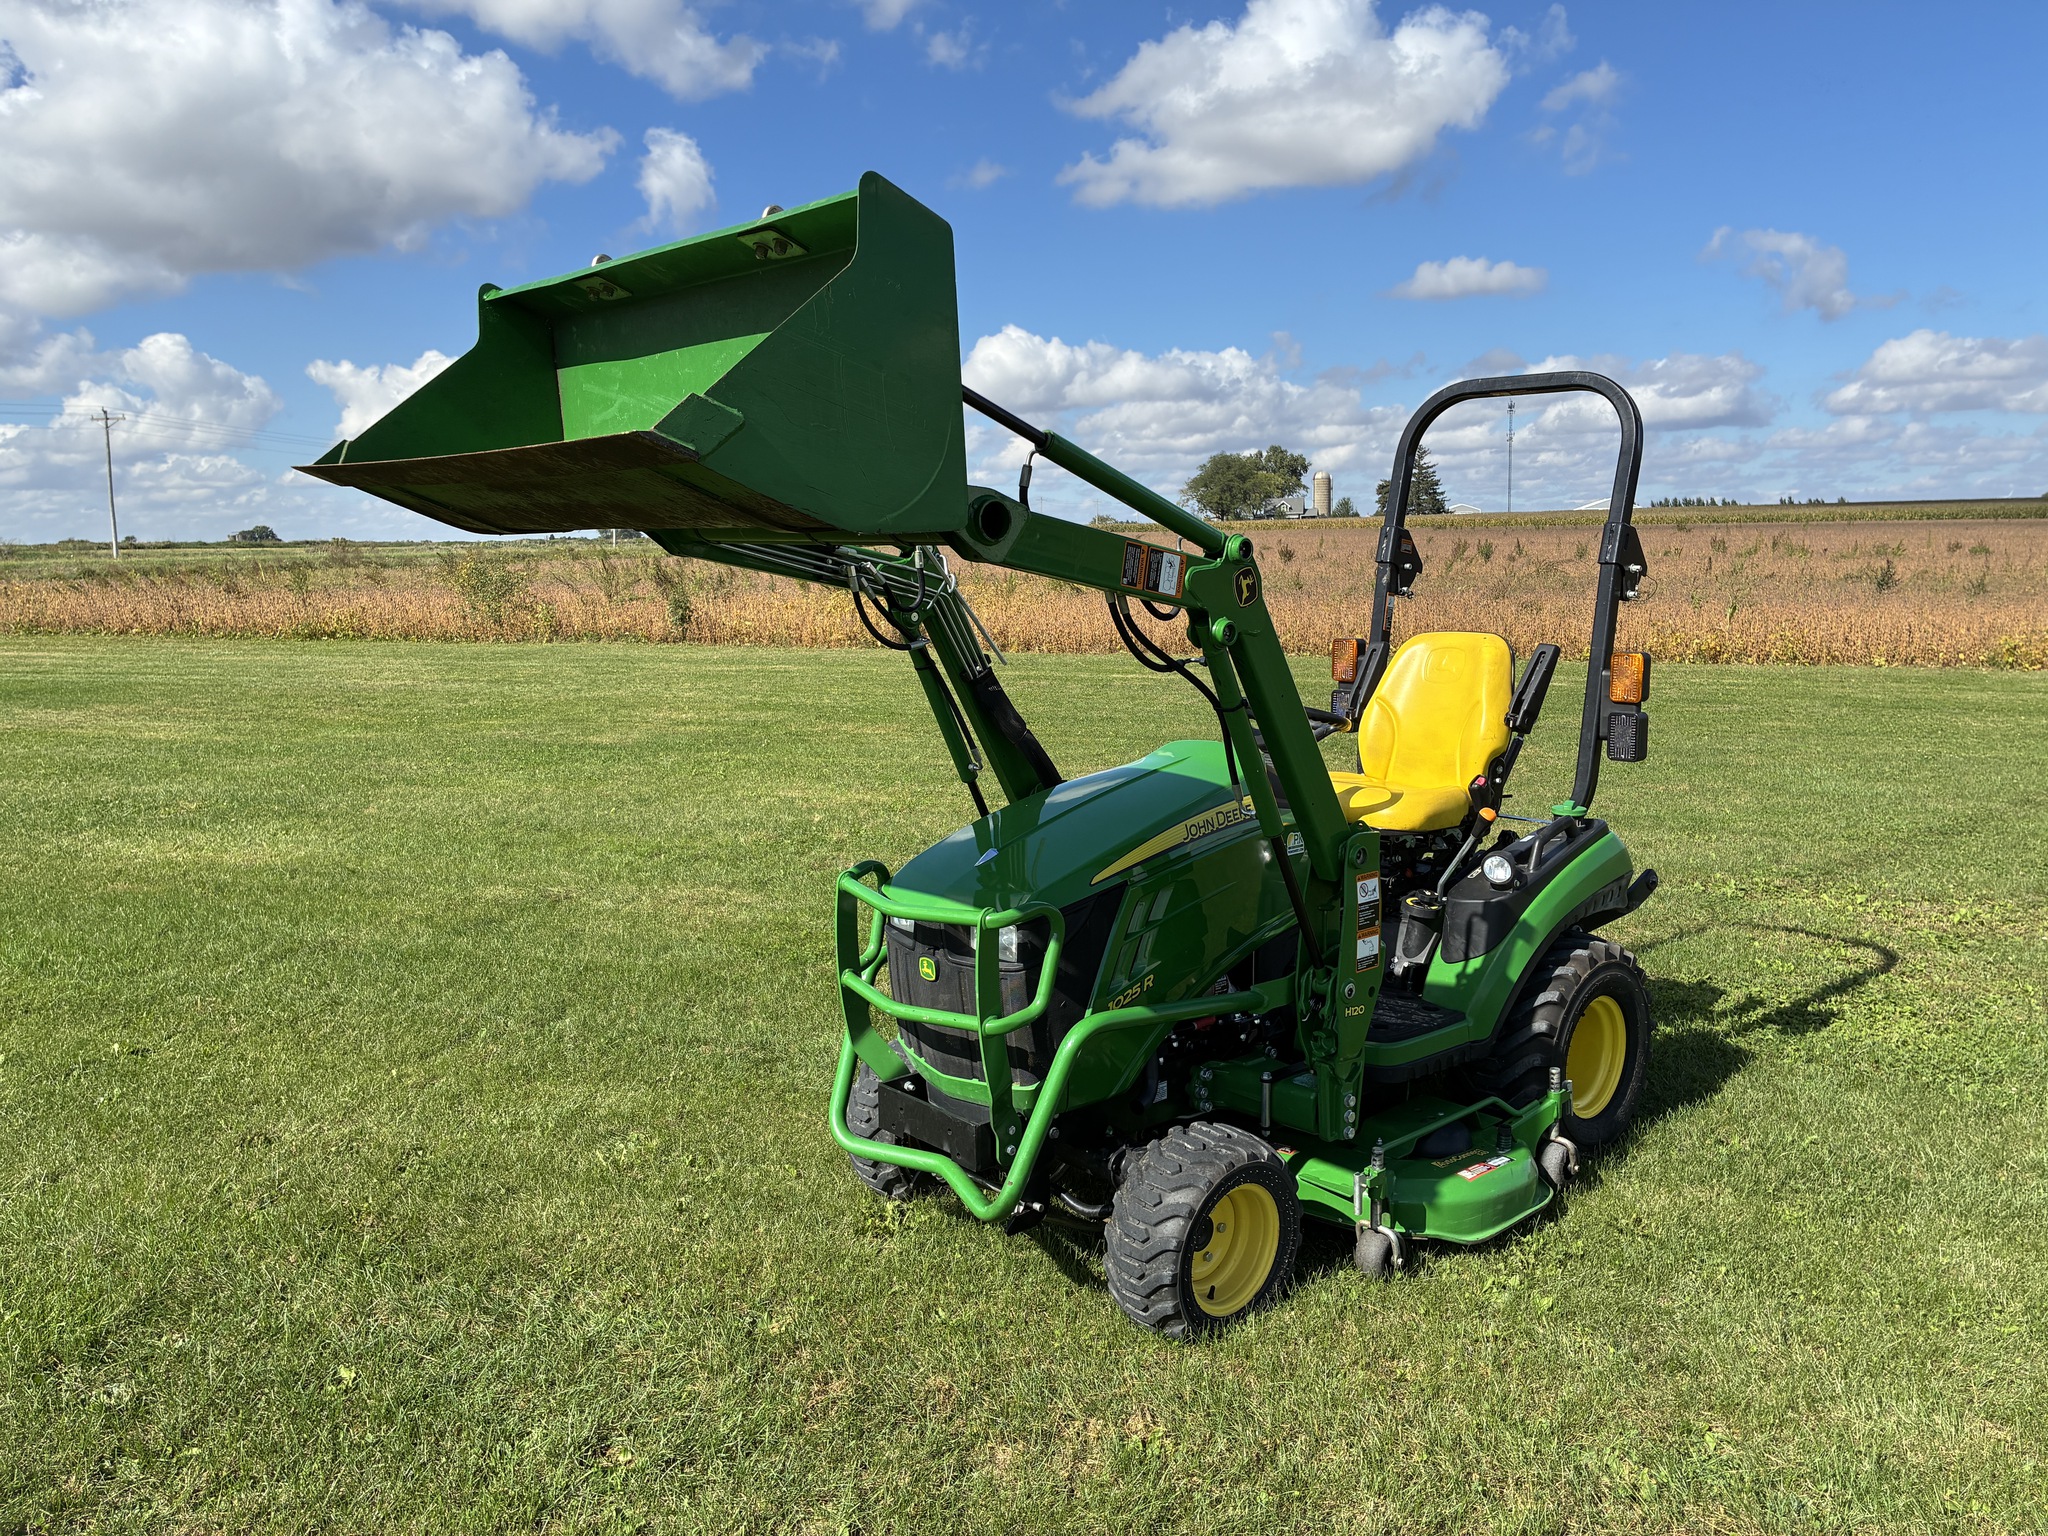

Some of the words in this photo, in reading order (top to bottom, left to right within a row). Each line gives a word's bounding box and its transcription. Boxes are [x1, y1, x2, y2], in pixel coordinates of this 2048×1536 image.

[1183, 817, 1215, 840] JOHN
[1107, 982, 1141, 1010] 1025
[1143, 974, 1154, 992] R
[1345, 1005, 1365, 1017] H120
